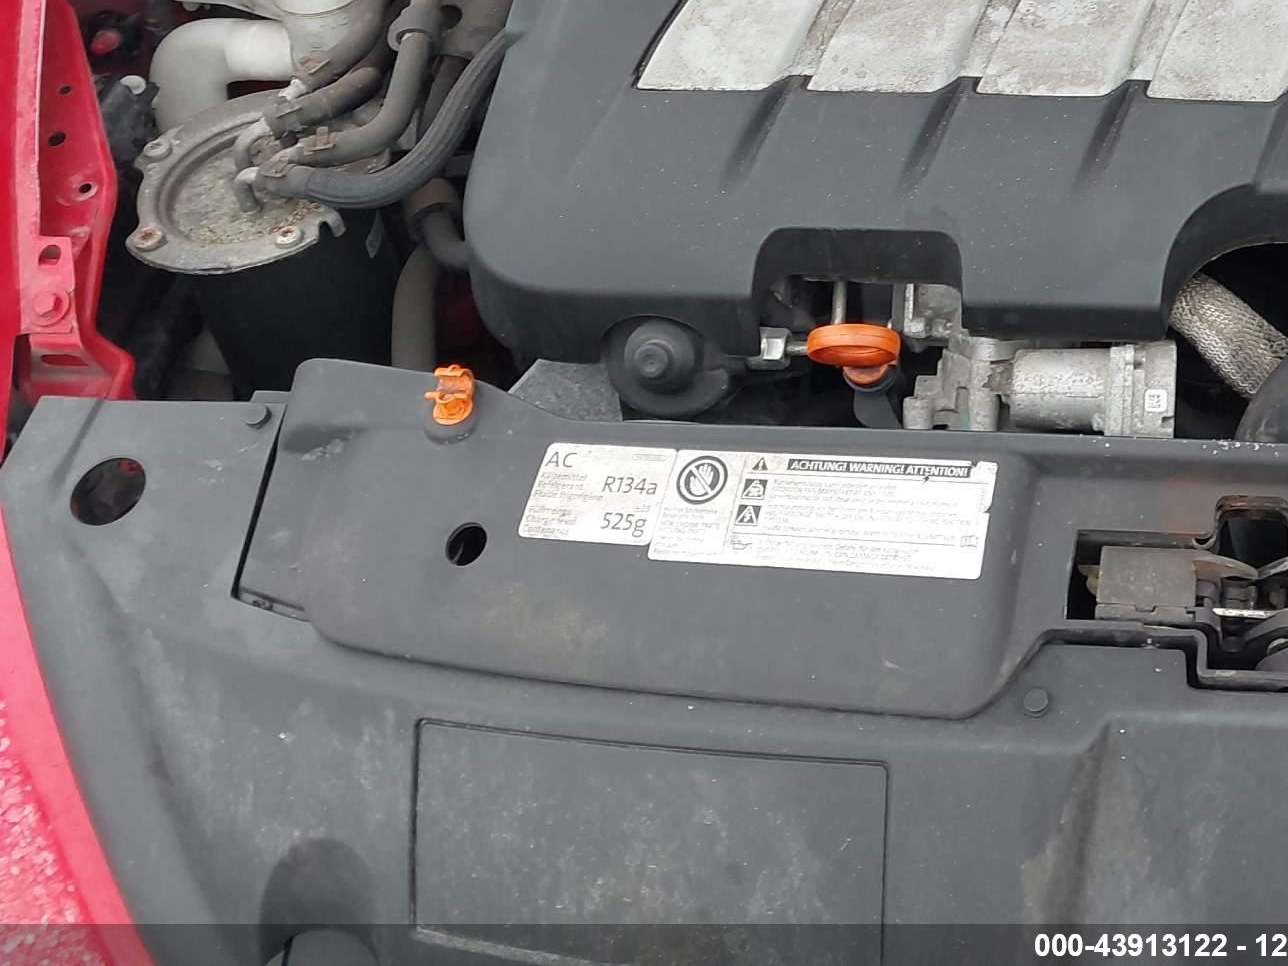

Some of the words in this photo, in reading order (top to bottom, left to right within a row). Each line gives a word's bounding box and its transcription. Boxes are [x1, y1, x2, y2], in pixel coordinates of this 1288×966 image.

[545, 451, 578, 468] AC
[790, 460, 849, 473] ACHTUNG!
[850, 462, 905, 475] WARNING!
[905, 465, 969, 478] ATTENTION!
[601, 475, 658, 496] R134a
[600, 512, 648, 538] 525g
